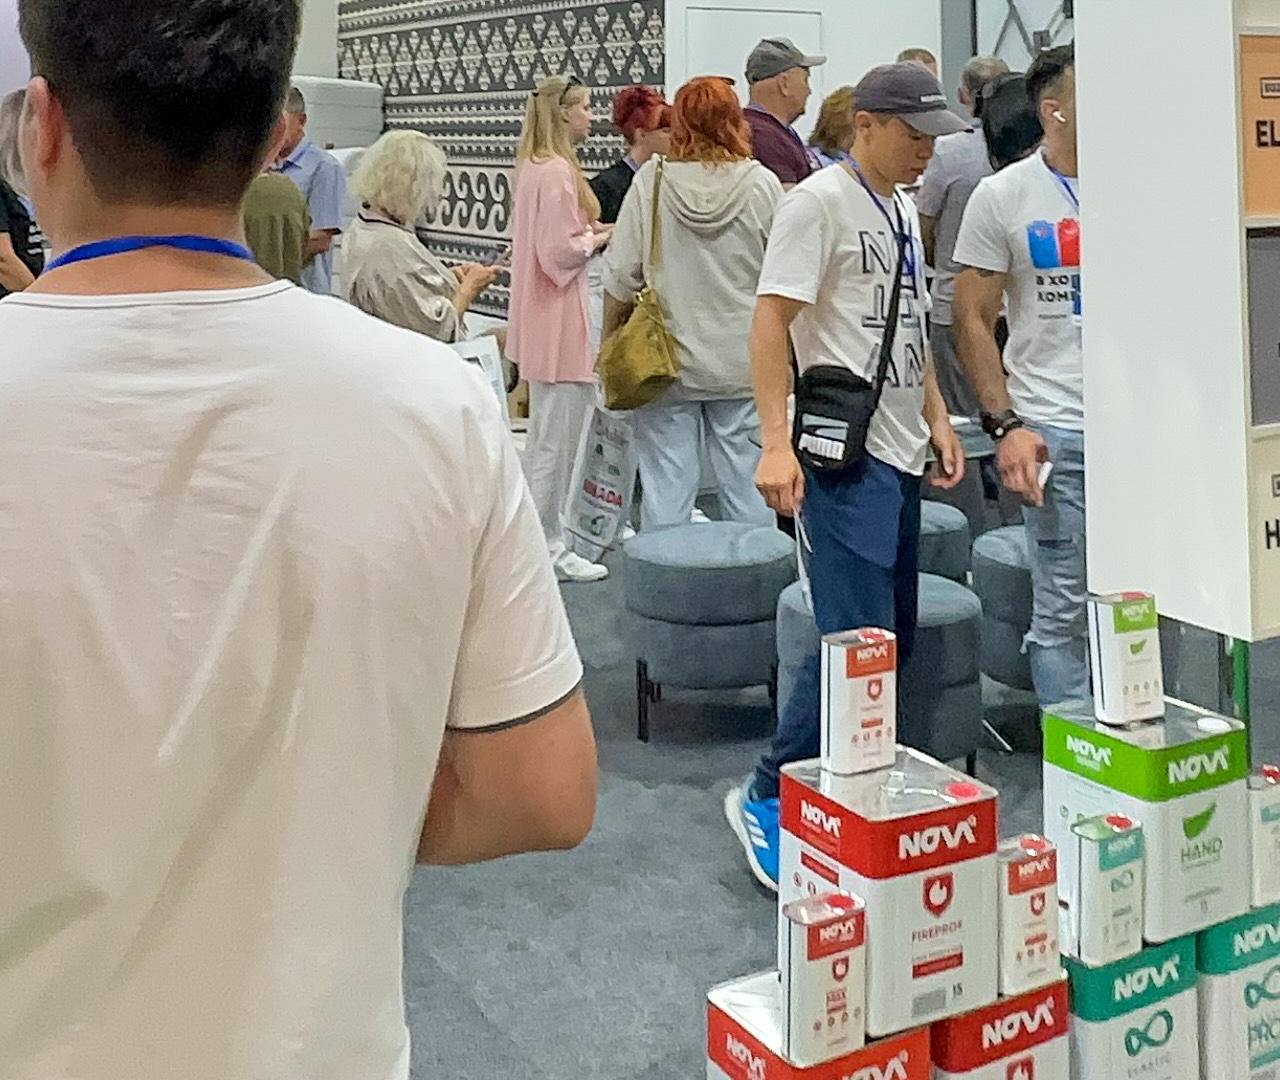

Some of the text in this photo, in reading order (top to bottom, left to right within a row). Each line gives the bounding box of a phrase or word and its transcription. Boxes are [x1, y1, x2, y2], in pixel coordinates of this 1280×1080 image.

[898, 814, 977, 860] NOVA
[1180, 837, 1223, 863] HAND
[981, 996, 1055, 1050] NOVA
